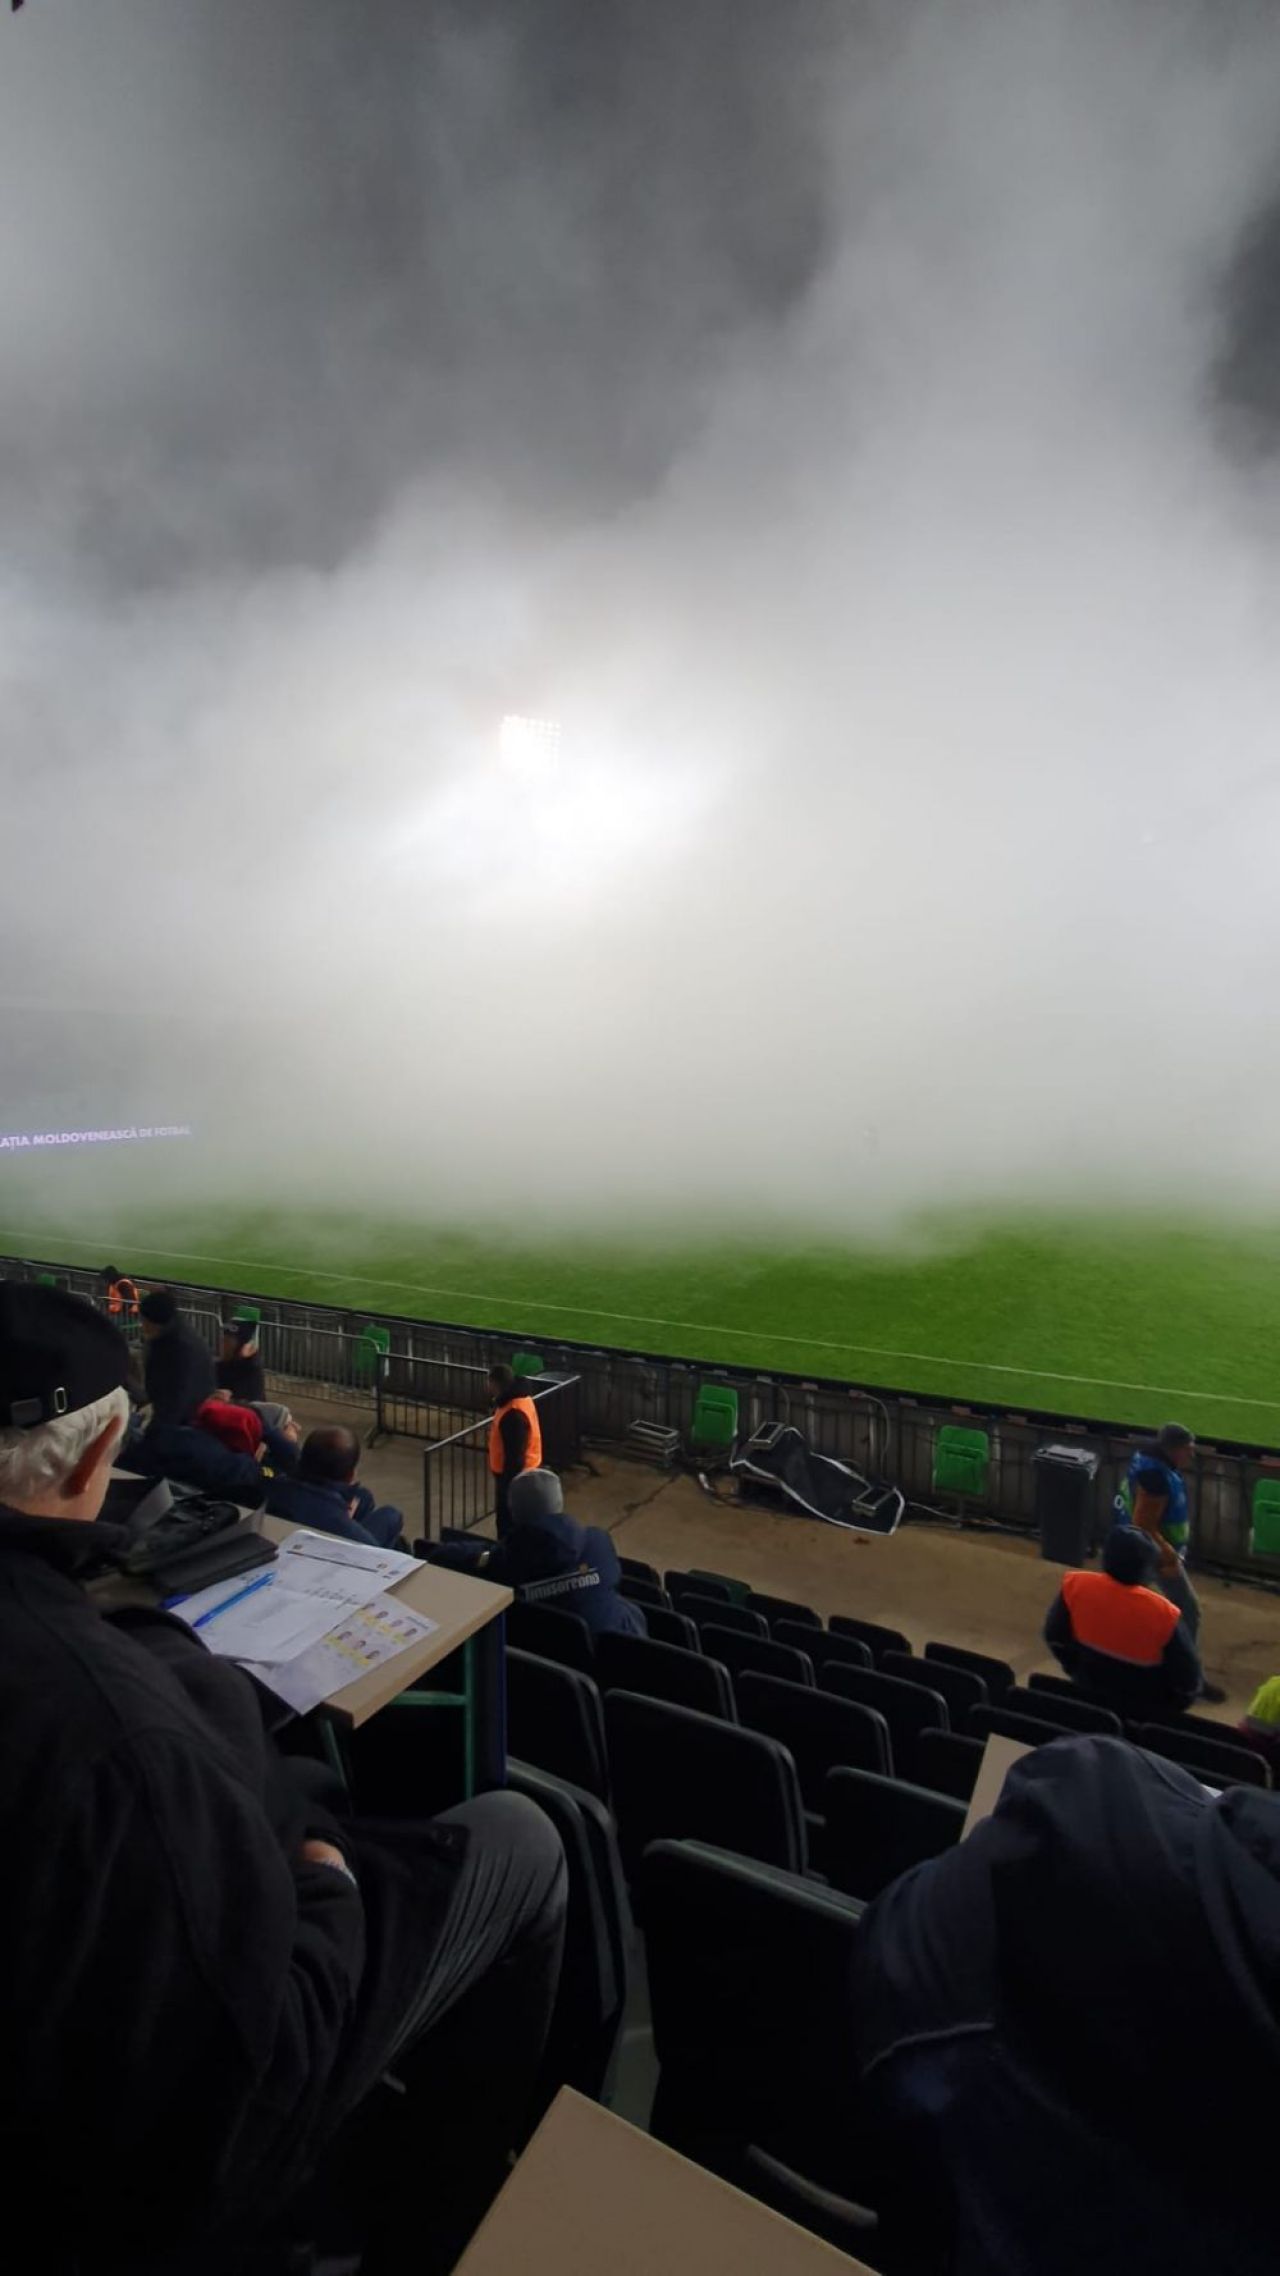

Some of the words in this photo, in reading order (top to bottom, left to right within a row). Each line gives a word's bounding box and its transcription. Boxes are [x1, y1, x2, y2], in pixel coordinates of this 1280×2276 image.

[0, 1135, 29, 1150] AȚIA
[33, 1127, 138, 1145] MOLDOVENEASCĂ
[140, 1128, 152, 1138] DE
